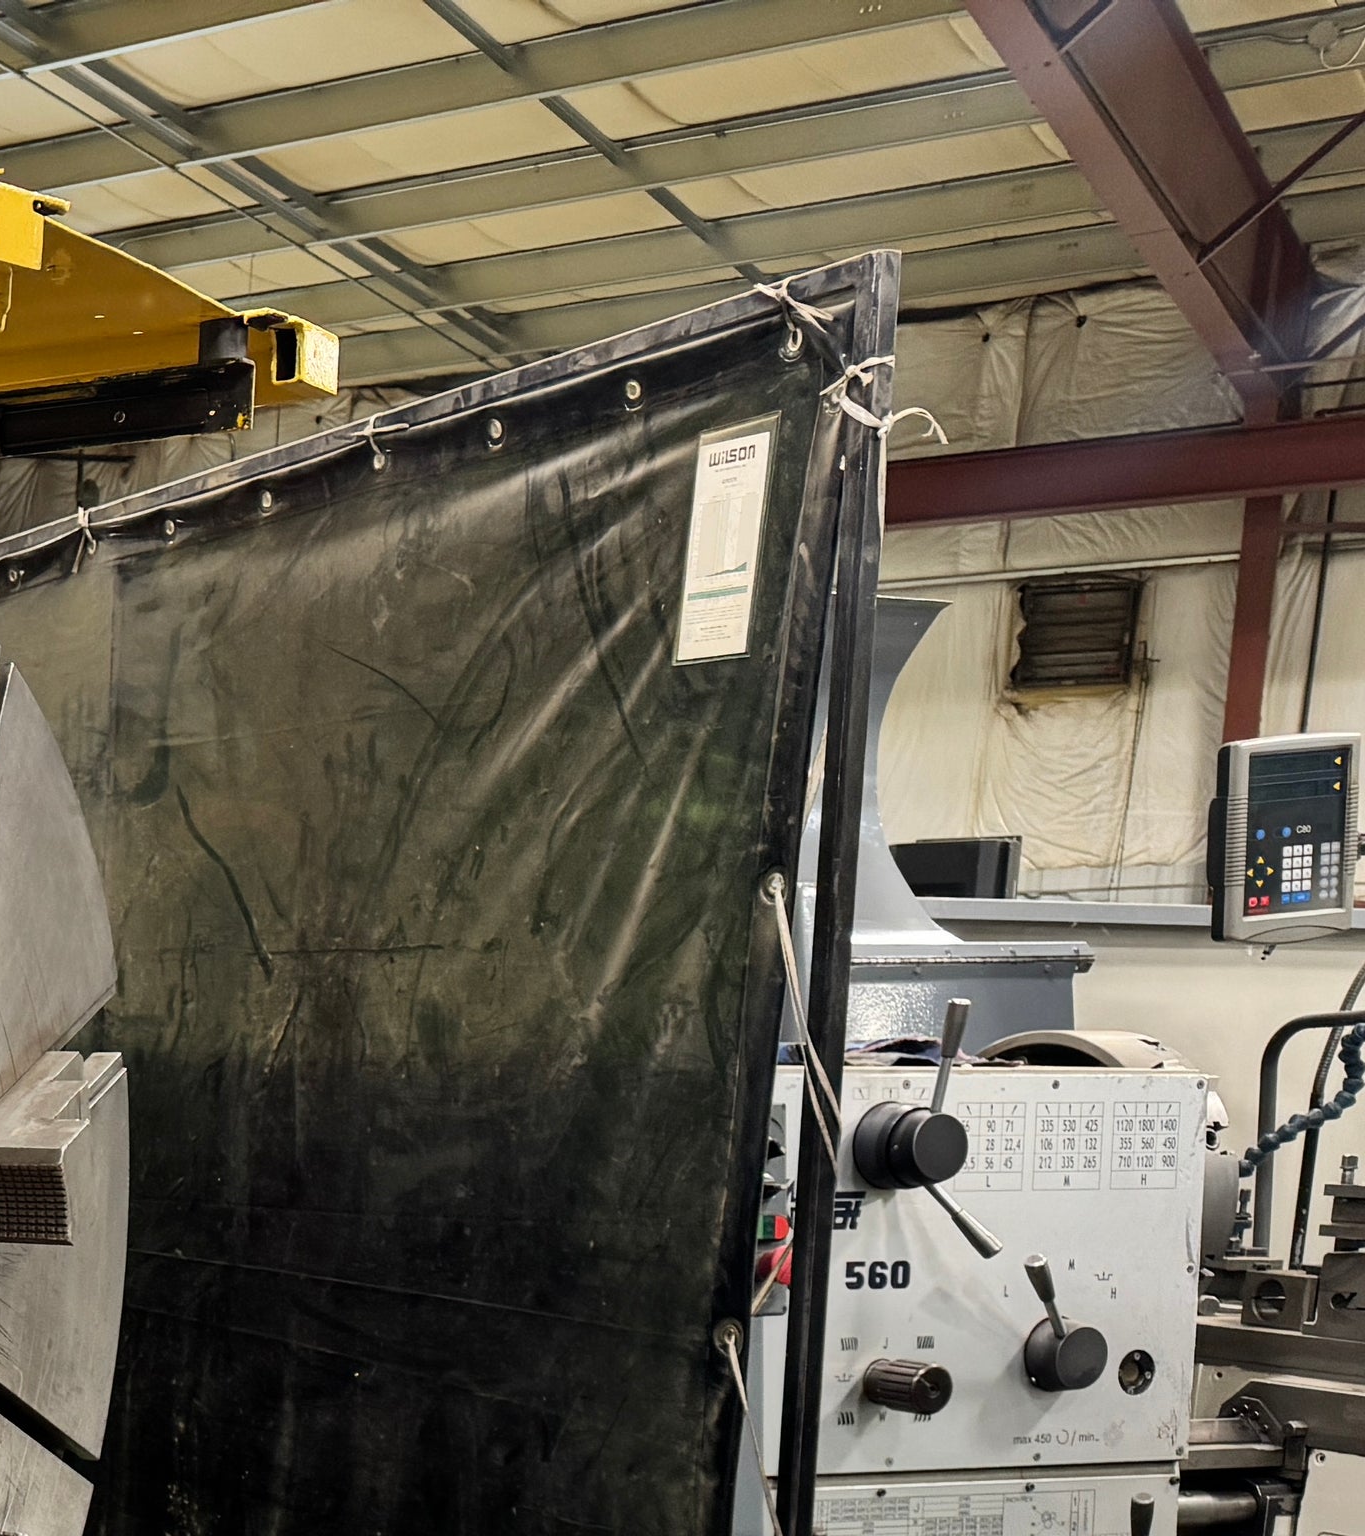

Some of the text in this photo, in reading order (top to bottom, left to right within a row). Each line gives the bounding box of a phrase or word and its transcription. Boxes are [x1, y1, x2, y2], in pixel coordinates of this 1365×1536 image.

[986, 1119, 996, 1133] 90
[1005, 1119, 1014, 1133] 71
[1040, 1119, 1098, 1133] 335 530 425
[1116, 1118, 1177, 1132] 1120 1800 1400
[985, 1138, 995, 1151] 28
[1040, 1137, 1097, 1151] 106 170 132
[1119, 1136, 1176, 1150] 355 560 450
[985, 1156, 994, 1170] 56
[1003, 1156, 1013, 1169] 45
[1039, 1155, 1097, 1169] 212 335 265
[1118, 1154, 1176, 1168] 710 1120 900
[986, 1175, 991, 1188] L
[1140, 1173, 1147, 1186] H
[1069, 1258, 1075, 1271] M
[845, 1260, 911, 1290] 560
[1110, 1286, 1117, 1300] H
[1034, 1433, 1052, 1444] 450
